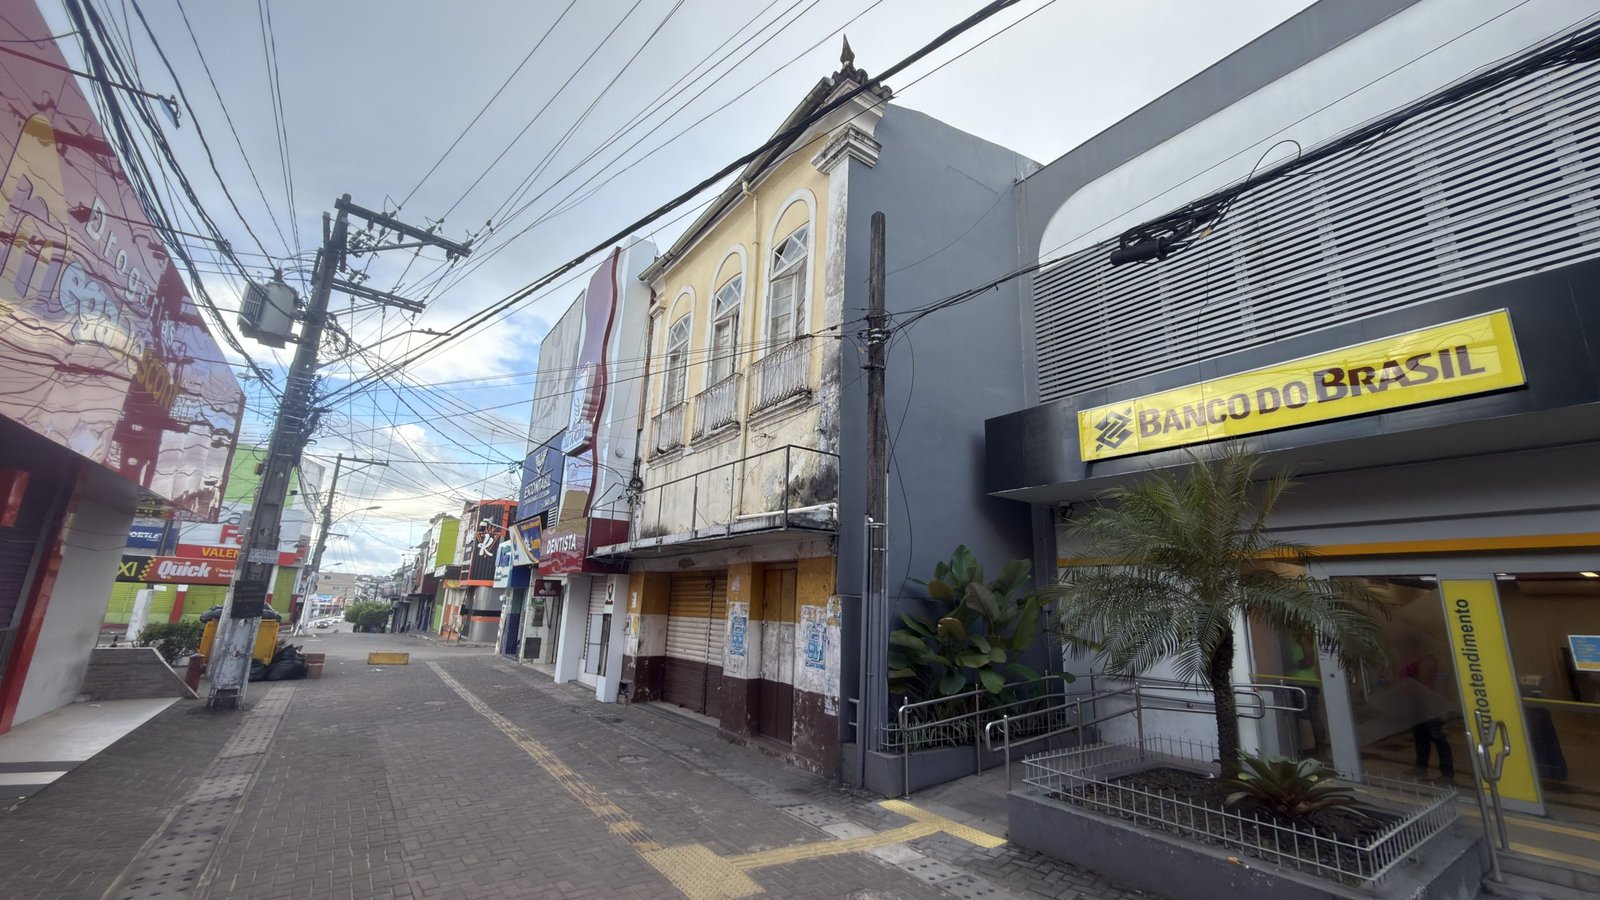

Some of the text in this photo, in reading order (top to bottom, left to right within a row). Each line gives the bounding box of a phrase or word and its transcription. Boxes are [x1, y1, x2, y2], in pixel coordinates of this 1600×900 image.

[84, 196, 176, 345] Drogarias
[1139, 344, 1486, 438] BANCO DO BRASIL
[202, 547, 240, 558] VALEN
[546, 533, 577, 555] DENTISTA
[116, 561, 138, 577] XI
[158, 560, 212, 579] Quick
